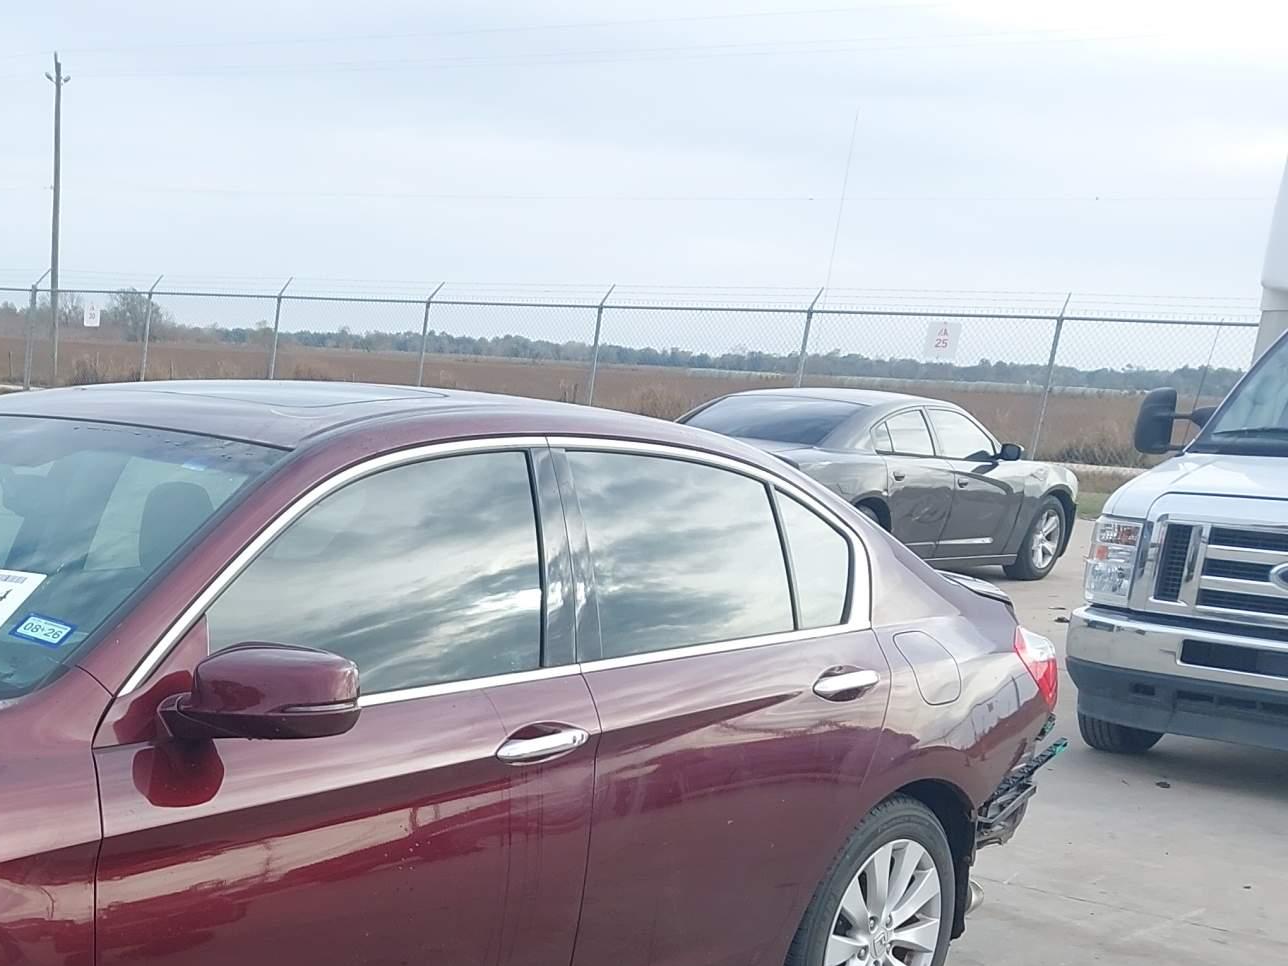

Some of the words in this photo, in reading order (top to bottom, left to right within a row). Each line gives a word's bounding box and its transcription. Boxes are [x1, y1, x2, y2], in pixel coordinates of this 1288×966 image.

[933, 338, 949, 348] 25
[23, 622, 42, 633] 08
[43, 628, 63, 639] 26
